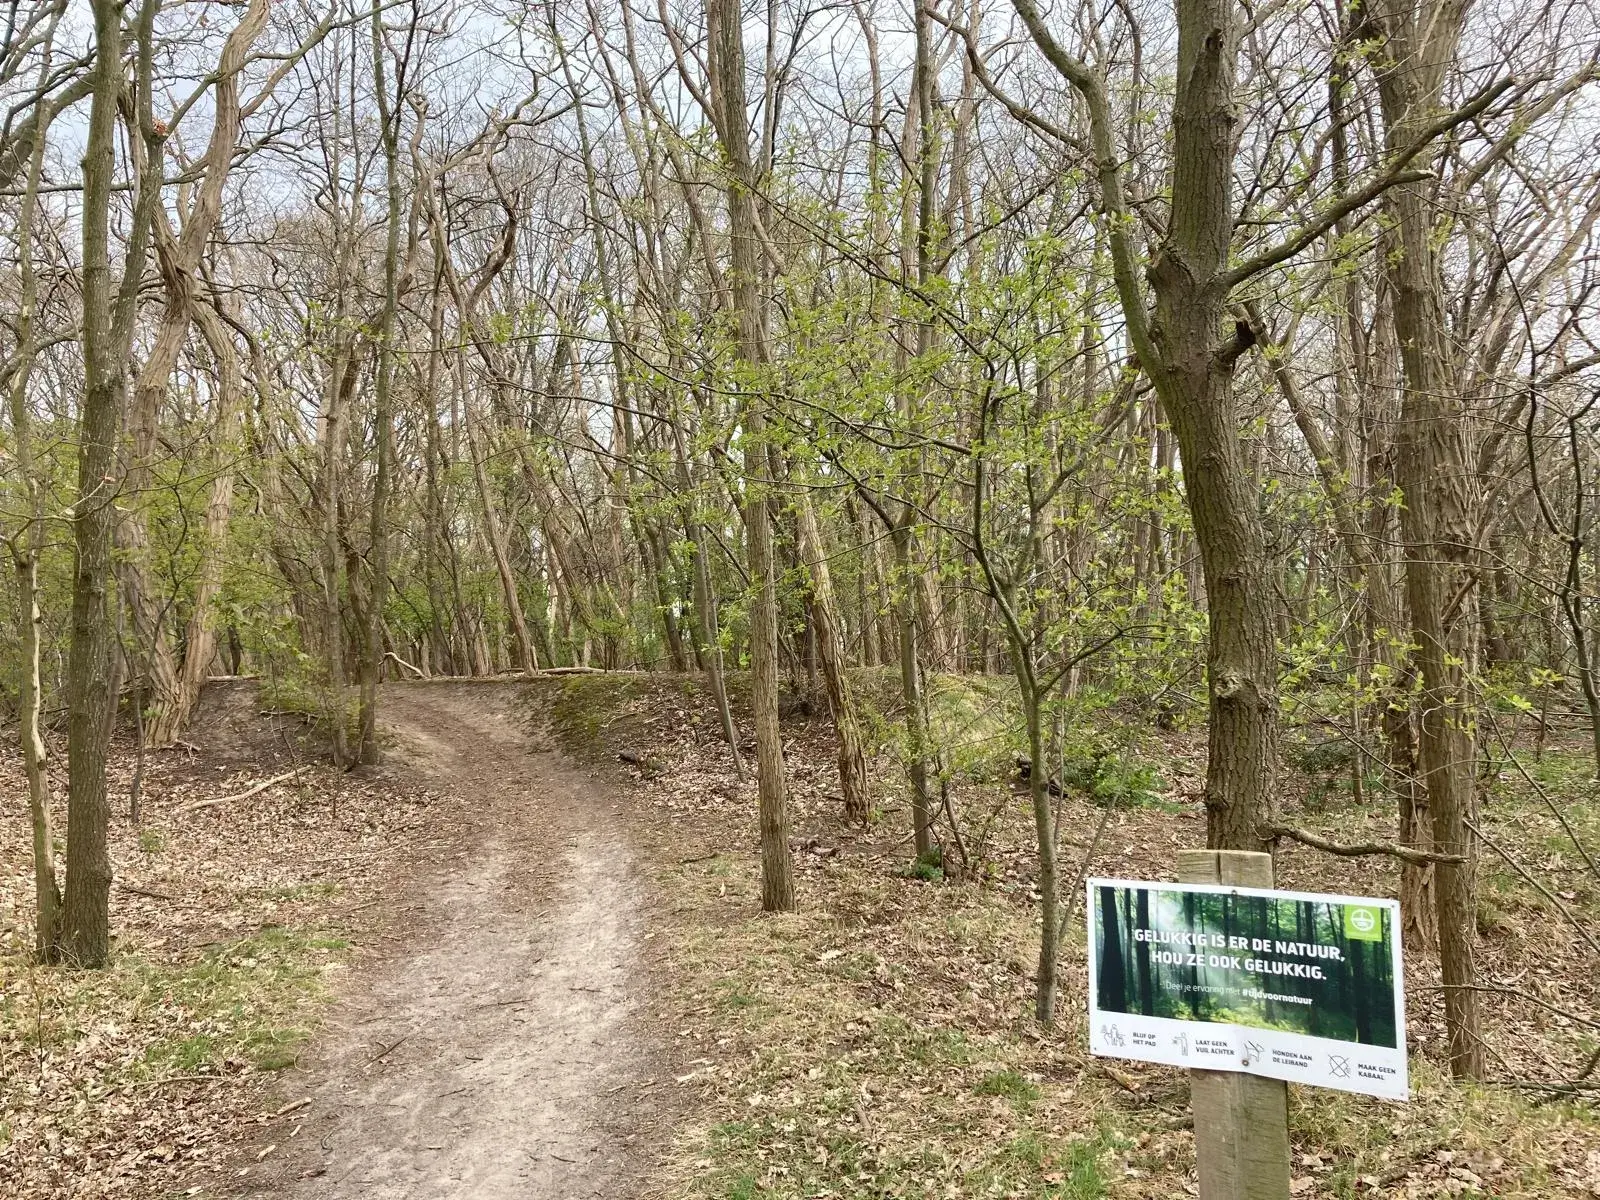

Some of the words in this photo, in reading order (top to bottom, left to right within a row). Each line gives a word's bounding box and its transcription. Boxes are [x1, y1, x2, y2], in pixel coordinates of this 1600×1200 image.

[1135, 929, 1207, 945] GELUKKIG
[1211, 934, 1225, 948] IS
[1230, 936, 1249, 950] ER
[1253, 938, 1271, 953] DE
[1275, 941, 1345, 962] NATUUR,
[1153, 951, 1183, 965] HOU
[1187, 954, 1205, 966] ZE
[1210, 956, 1241, 970] OOK
[1245, 959, 1327, 980] GELUKKIG.
[1166, 982, 1183, 991] Deel
[1193, 985, 1224, 994] ervaring
[1226, 987, 1240, 995] met
[1242, 988, 1313, 1005] #tijdvoornatuur
[1211, 1048, 1234, 1056] ACHTER
[1273, 1049, 1298, 1058] HONDEN
[1281, 1058, 1308, 1067] LEIBAND
[1358, 1071, 1384, 1080] KABAAL
